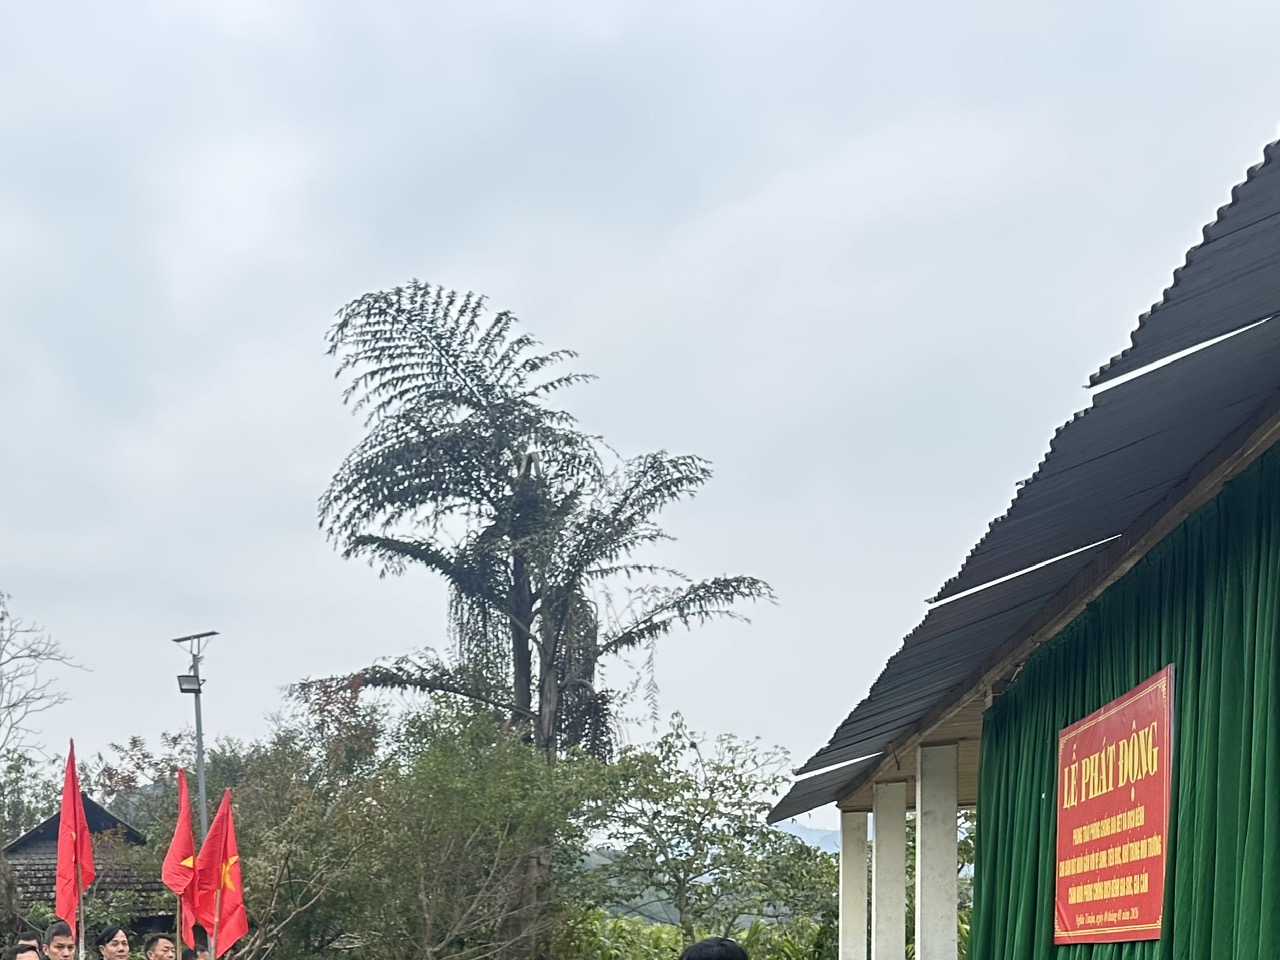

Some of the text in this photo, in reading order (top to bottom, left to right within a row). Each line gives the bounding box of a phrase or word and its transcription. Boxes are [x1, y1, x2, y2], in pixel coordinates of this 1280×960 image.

[1063, 718, 1158, 808] LỄ PHÁT ĐỘNG
